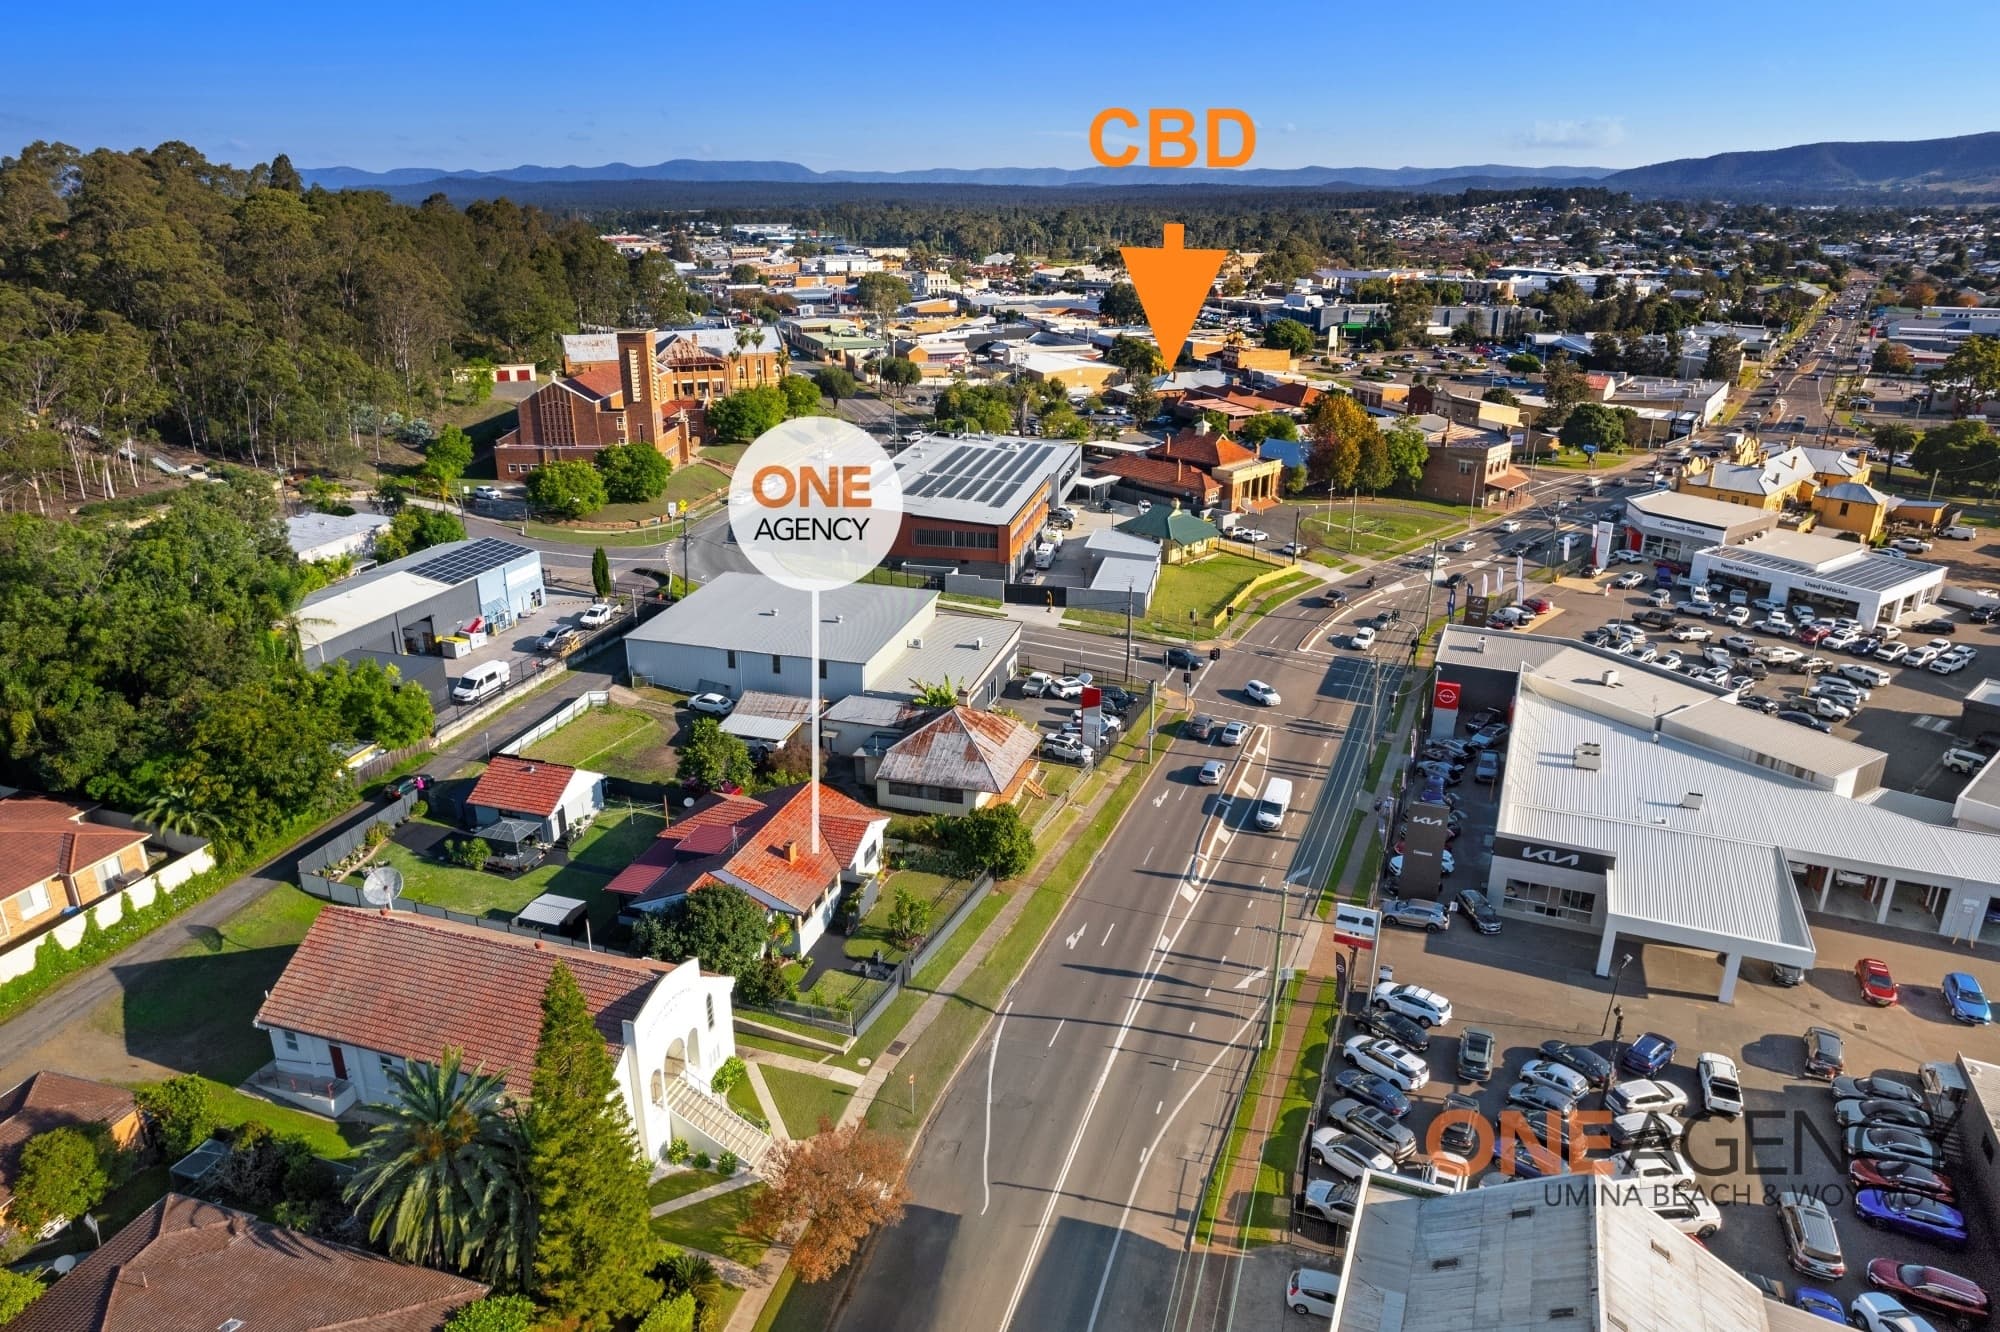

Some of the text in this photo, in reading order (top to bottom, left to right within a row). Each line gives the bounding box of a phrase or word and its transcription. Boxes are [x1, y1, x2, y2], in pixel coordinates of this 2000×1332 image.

[1721, 562, 1759, 576] New Vehicles
[1804, 580, 1848, 595] Used Vehicles
